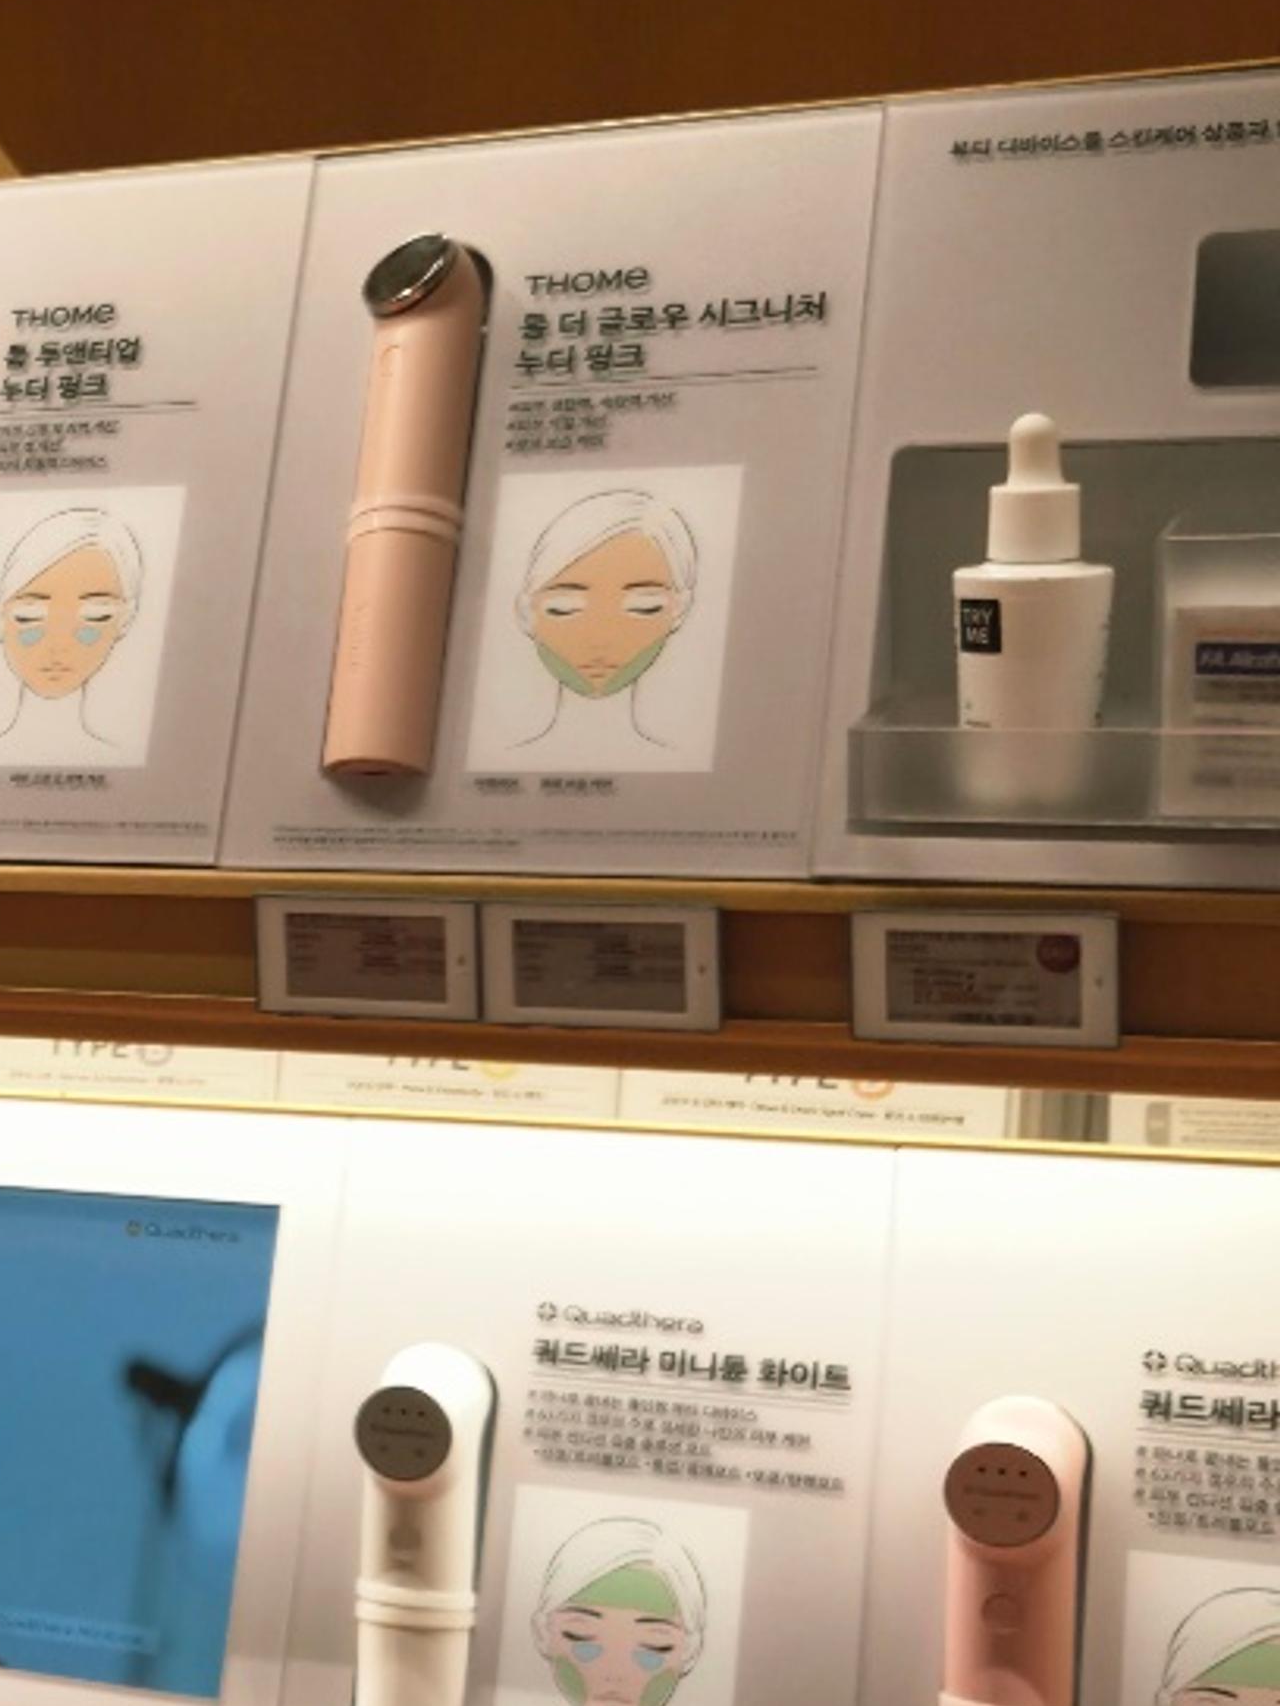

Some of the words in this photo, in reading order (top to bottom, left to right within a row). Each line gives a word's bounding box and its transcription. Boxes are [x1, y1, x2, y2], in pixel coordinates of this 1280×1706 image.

[558, 309, 587, 336] 더
[596, 303, 689, 334] 글로우
[697, 291, 828, 328] 시그니처
[514, 346, 575, 375] 누디
